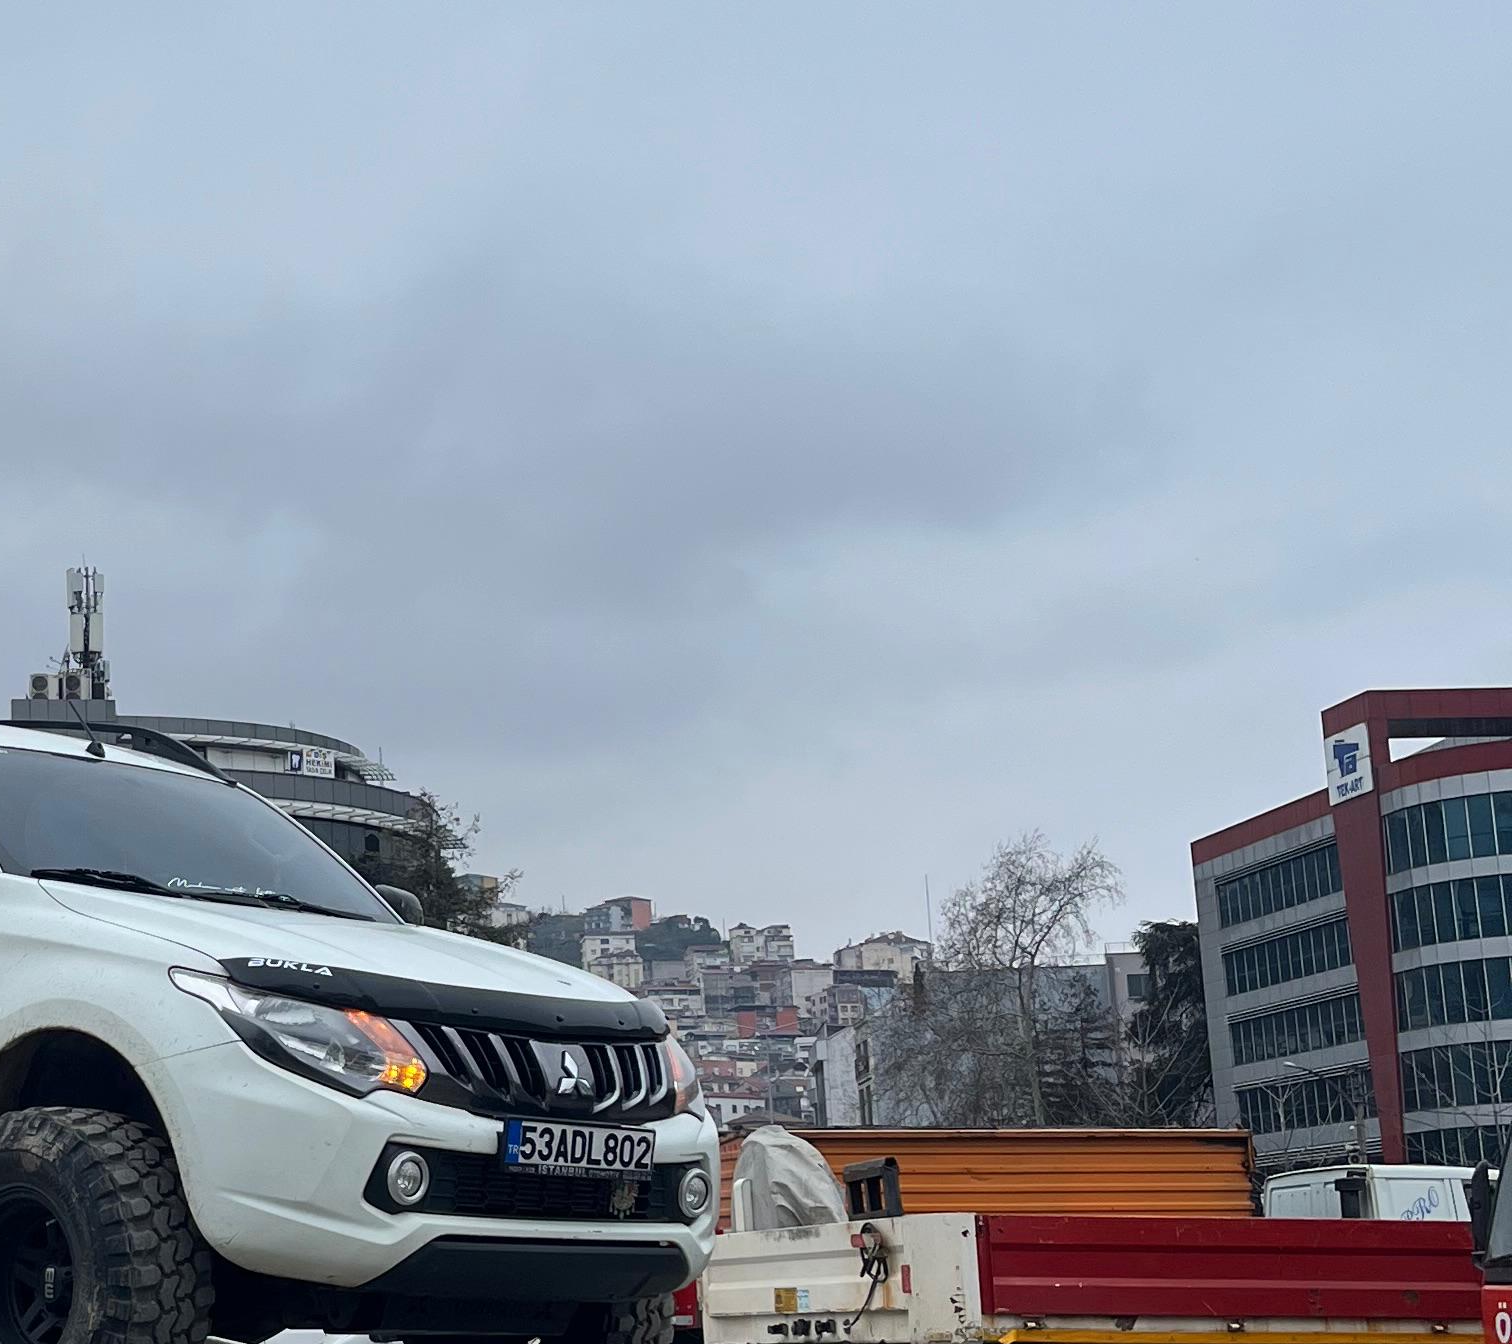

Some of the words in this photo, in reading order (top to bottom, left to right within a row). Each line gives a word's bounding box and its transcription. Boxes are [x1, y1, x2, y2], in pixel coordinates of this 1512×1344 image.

[248, 958, 334, 977] BUKLA
[507, 1144, 519, 1155] TR
[520, 1125, 652, 1169] 53ADL802
